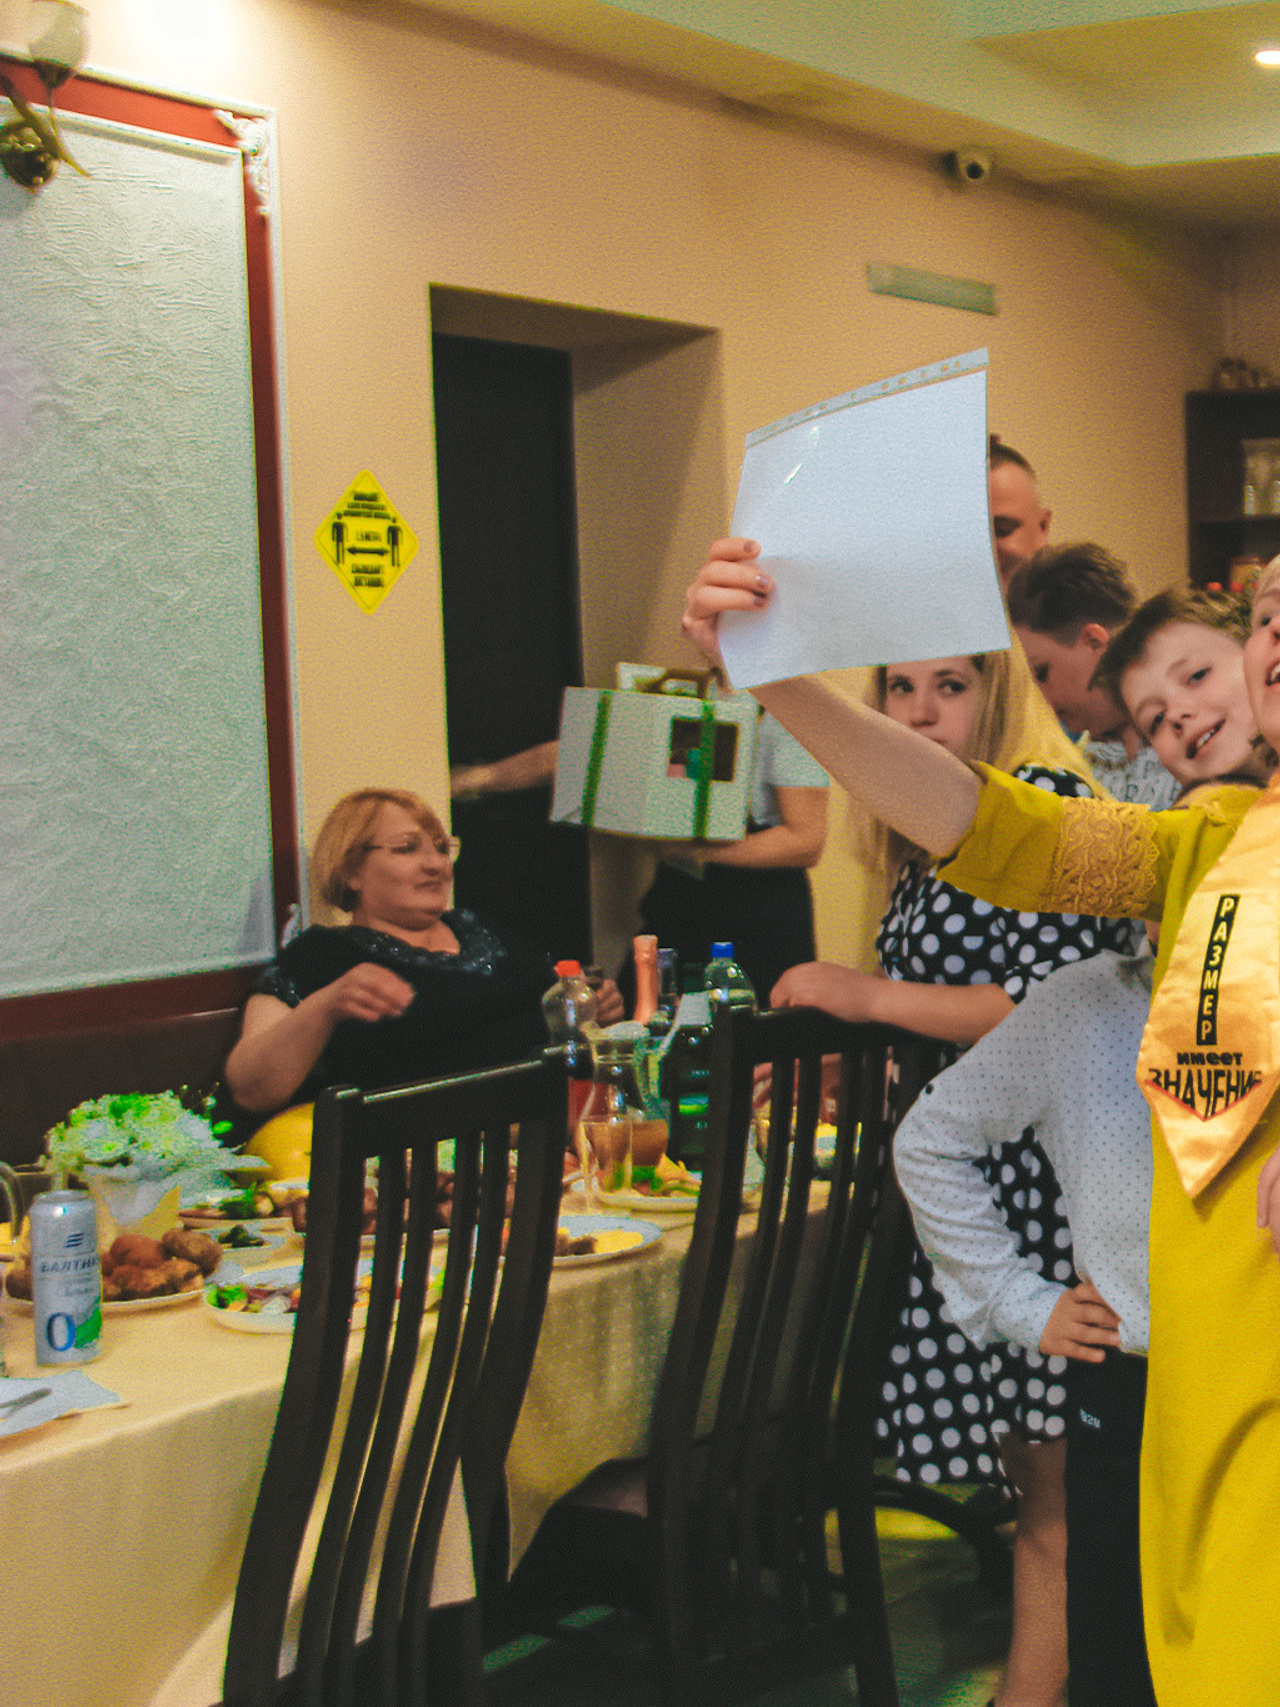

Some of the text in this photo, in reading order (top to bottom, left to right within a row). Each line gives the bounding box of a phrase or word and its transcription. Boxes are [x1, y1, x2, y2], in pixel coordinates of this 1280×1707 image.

[1200, 897, 1235, 1041] РАЗМЕР
[1148, 1068, 1263, 1119] ЗНАЧЕНИЕ
[46, 1312, 76, 1352] 0
